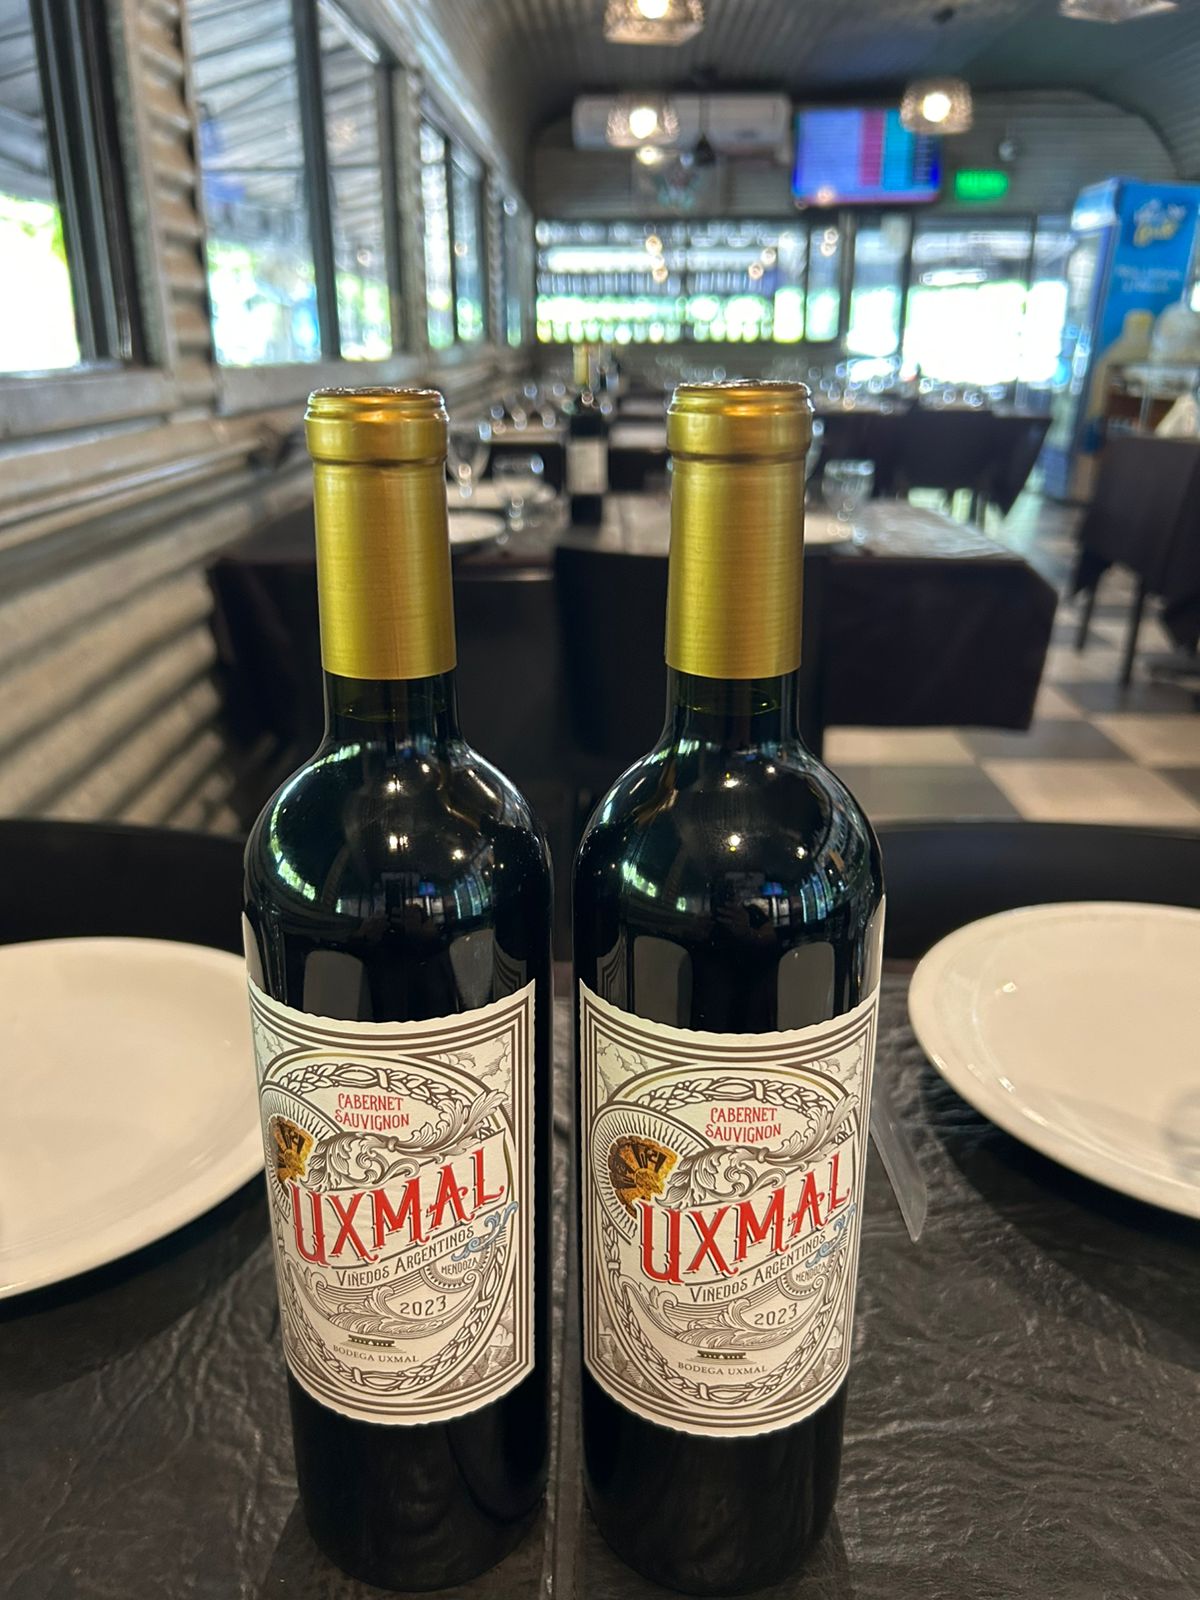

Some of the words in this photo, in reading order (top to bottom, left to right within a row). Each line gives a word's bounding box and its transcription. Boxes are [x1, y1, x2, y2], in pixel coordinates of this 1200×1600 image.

[338, 1093, 404, 1111] CABERNET
[334, 1109, 409, 1131] SAUVIGNON
[710, 1107, 778, 1124] CABERNET
[705, 1123, 781, 1144] SAUVIGNON
[287, 1147, 504, 1266] UXMAL
[637, 1151, 850, 1285] UXMAL
[336, 1266, 390, 1287] VIÑEDOS
[394, 1225, 475, 1275] ARGENTINOS
[441, 1257, 478, 1275] MENDOZA
[689, 1278, 748, 1302] VIÑEDOS
[753, 1231, 826, 1285] ARGENTINOS
[400, 1295, 447, 1316] 2023
[754, 1302, 798, 1326] 2023
[333, 1344, 375, 1363] BODEGA
[378, 1354, 419, 1363] UXMAL
[678, 1361, 724, 1376] BODEGA
[728, 1364, 768, 1376] UXMAL
